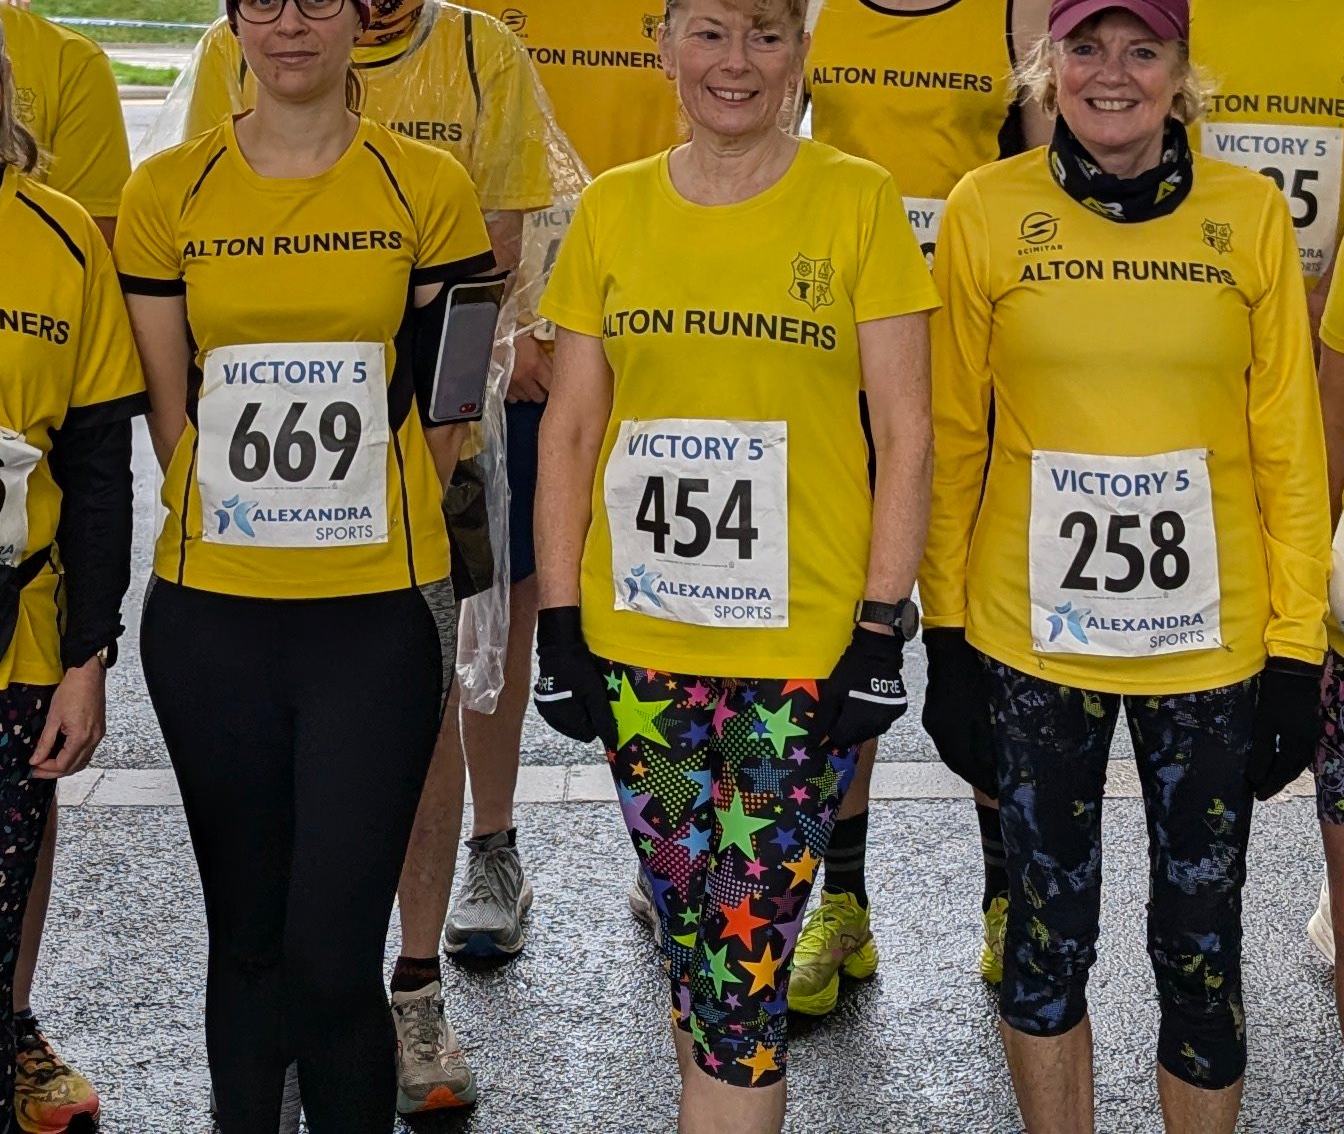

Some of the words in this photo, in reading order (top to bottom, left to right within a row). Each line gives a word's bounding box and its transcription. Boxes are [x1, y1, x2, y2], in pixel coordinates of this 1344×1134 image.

[526, 47, 566, 65] TON
[812, 66, 876, 86] ALTON
[883, 70, 993, 93] RUNNERS
[1215, 134, 1308, 156] VICTORY
[1315, 140, 1327, 157] 5
[183, 236, 265, 260] ALTON
[273, 230, 403, 256] RUNNERS
[1019, 259, 1109, 283] ALTON
[1113, 259, 1237, 286] RUNNERS
[602, 309, 674, 339] ALTON
[683, 309, 836, 352] RUNNERS
[223, 360, 346, 385] VICTORY
[352, 362, 367, 384] 5
[227, 401, 362, 484] 669
[626, 433, 740, 461] VICTORY
[747, 438, 764, 461] 5
[1050, 467, 1170, 498] VICTORY
[1175, 469, 1190, 493] 5
[252, 506, 373, 523] ALEXANDRA
[635, 476, 759, 561] 454
[315, 525, 374, 541] SPORTS
[1059, 510, 1191, 593] 258
[656, 580, 772, 601] ALEXANDRA
[714, 604, 772, 620] SPORTS
[1086, 611, 1205, 632] ALEXANDRA
[1149, 630, 1205, 649] SPORTS
[870, 677, 901, 695] GORE
